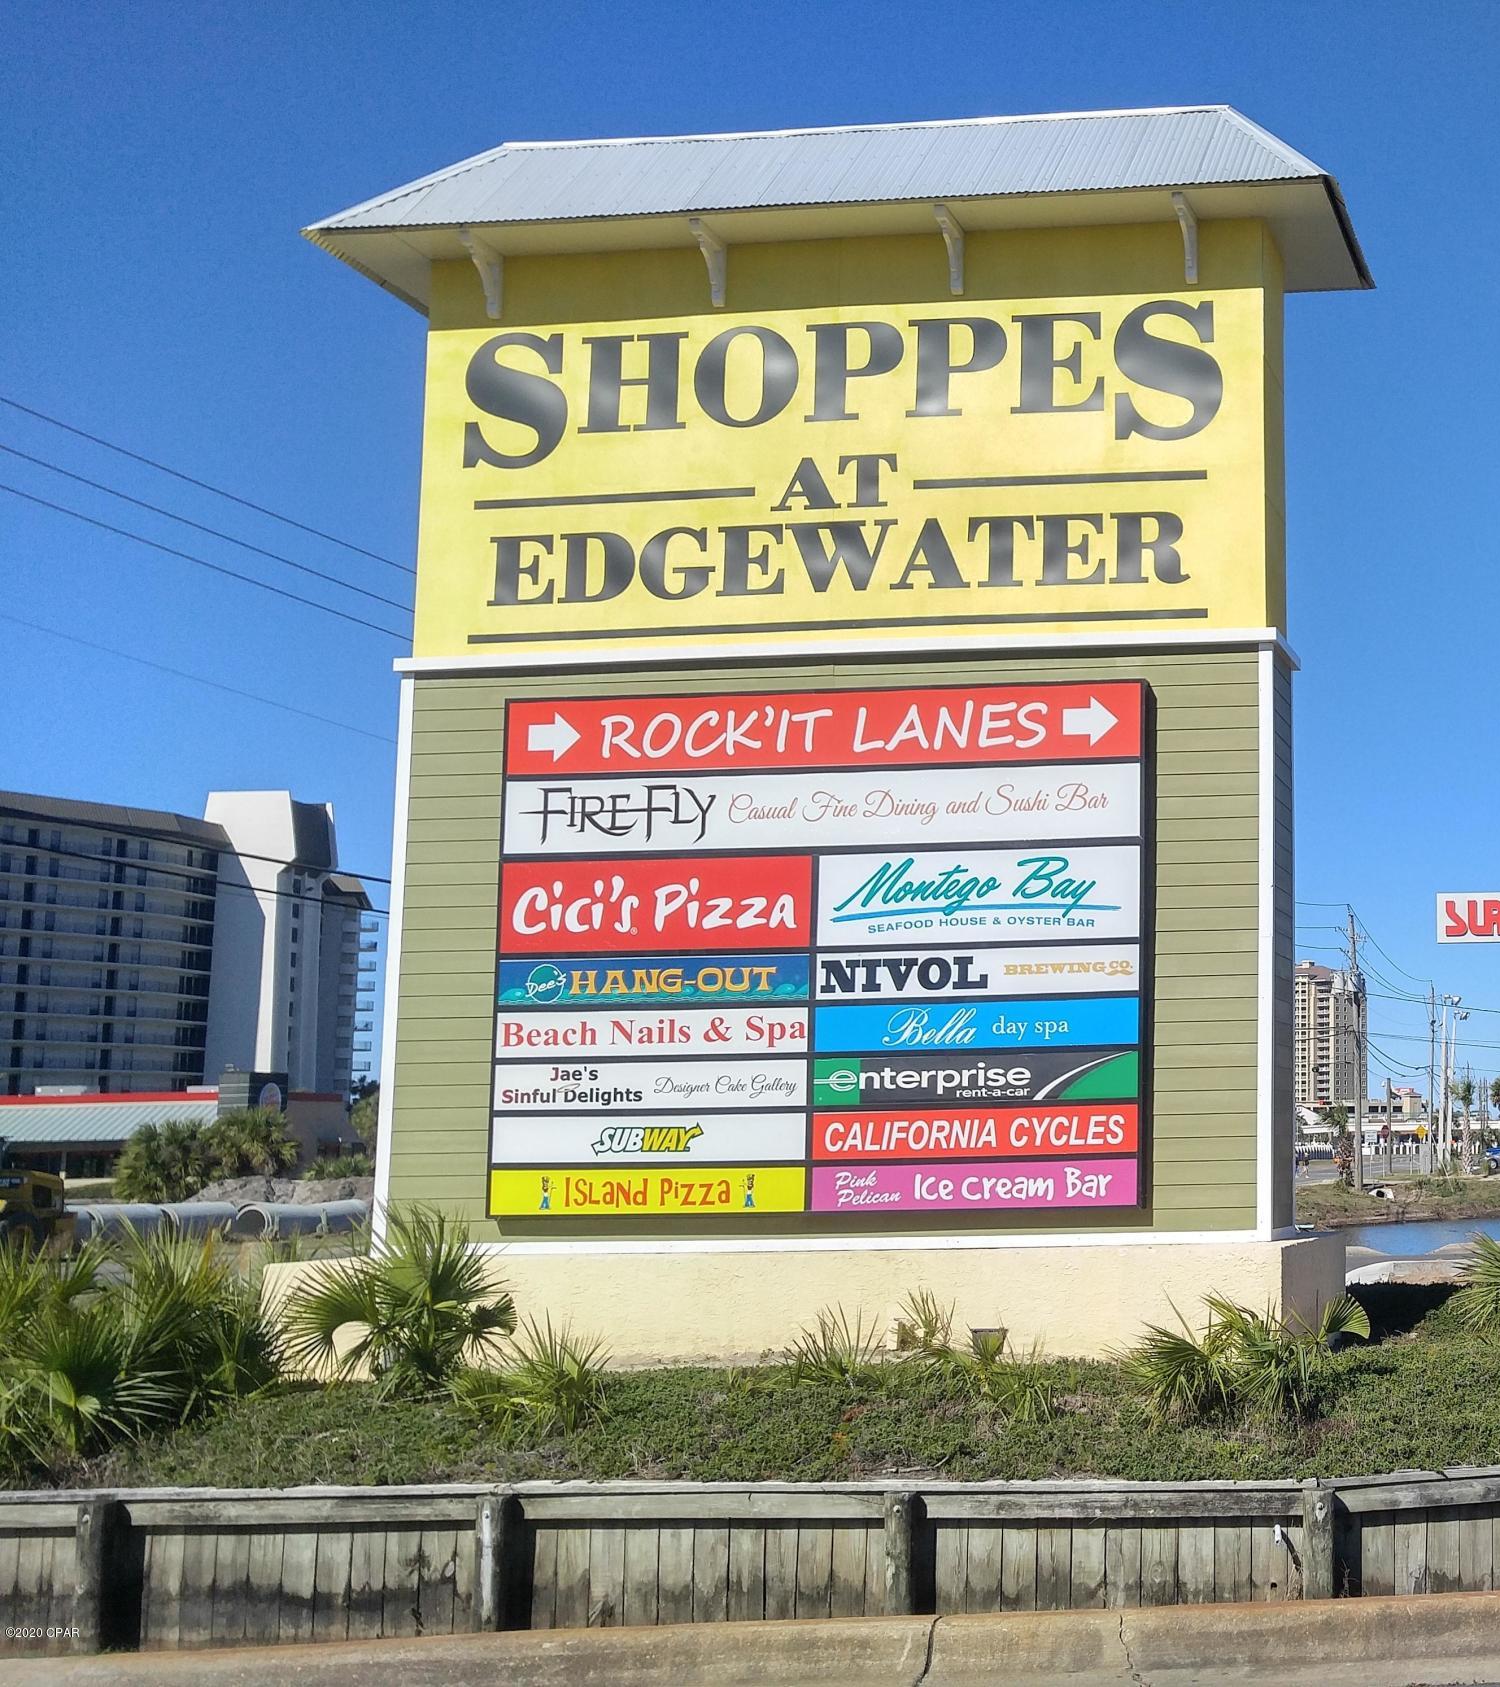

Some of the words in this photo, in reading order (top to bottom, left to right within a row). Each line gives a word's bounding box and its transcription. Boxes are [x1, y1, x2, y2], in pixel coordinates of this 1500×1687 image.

[463, 300, 1223, 469] SHOPPES
[770, 453, 897, 512] AT
[486, 511, 1191, 607] EDGEWATER
[601, 705, 833, 759] ROCK'IT
[853, 700, 1048, 753] LANES
[729, 793, 798, 823] Casual
[802, 791, 858, 822] Fine
[863, 789, 939, 825] Dining
[946, 791, 982, 815] and
[985, 784, 1049, 815] Sushi
[1054, 783, 1109, 811] Bar
[833, 857, 1001, 916] Montego
[1012, 856, 1096, 918] Bay
[654, 877, 797, 932] Pizza
[867, 918, 934, 934] SEAFOOD
[938, 916, 987, 928] HOUSE
[992, 916, 1001, 926] &
[1007, 916, 1061, 926] OYSTER
[1066, 916, 1096, 928] BAR
[569, 966, 777, 995] HANG-OUT
[820, 956, 988, 994] NIVOL
[1003, 962, 1106, 976] BREWING
[501, 1021, 597, 1048] Beach
[610, 1018, 691, 1045] Nails
[703, 1016, 732, 1043] &
[745, 1015, 807, 1048] Spa
[881, 1007, 977, 1047] Bella
[992, 1014, 1027, 1041] day
[1034, 1018, 1069, 1040] spa
[550, 1066, 599, 1082] Jae's
[654, 1076, 710, 1099] Designer
[715, 1075, 747, 1094] Cake
[749, 1073, 798, 1099] Gallery
[829, 1062, 1032, 1094] enterprise
[501, 1088, 557, 1104] Sinful
[563, 1086, 643, 1106] Delights
[956, 1086, 1031, 1098] rent-a-car
[591, 1122, 704, 1156] SUBWAY
[824, 1117, 998, 1152] CALIFORNIA
[1009, 1113, 1125, 1148] CYCLES
[659, 1177, 731, 1207] Pizza
[835, 1170, 878, 1191] Pink
[914, 1173, 954, 1201] Ice
[1063, 1166, 1113, 1199] Bar
[837, 1189, 902, 1207] Pelican
